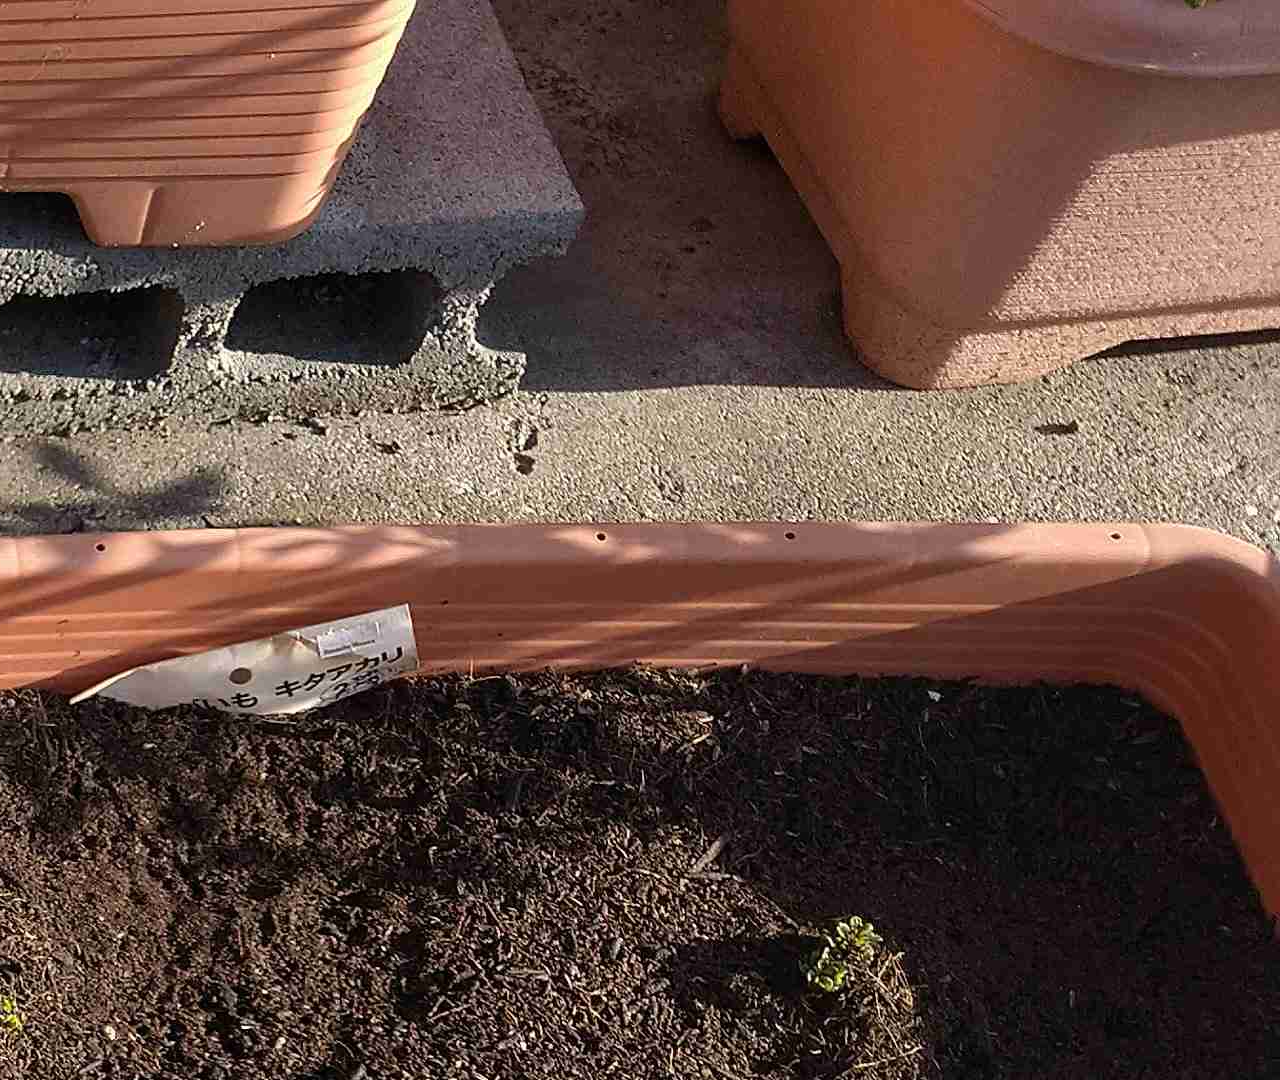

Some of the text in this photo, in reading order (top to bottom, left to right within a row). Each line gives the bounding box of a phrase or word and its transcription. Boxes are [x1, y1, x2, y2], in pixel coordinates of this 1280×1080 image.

[275, 647, 403, 697] キタアカリ
